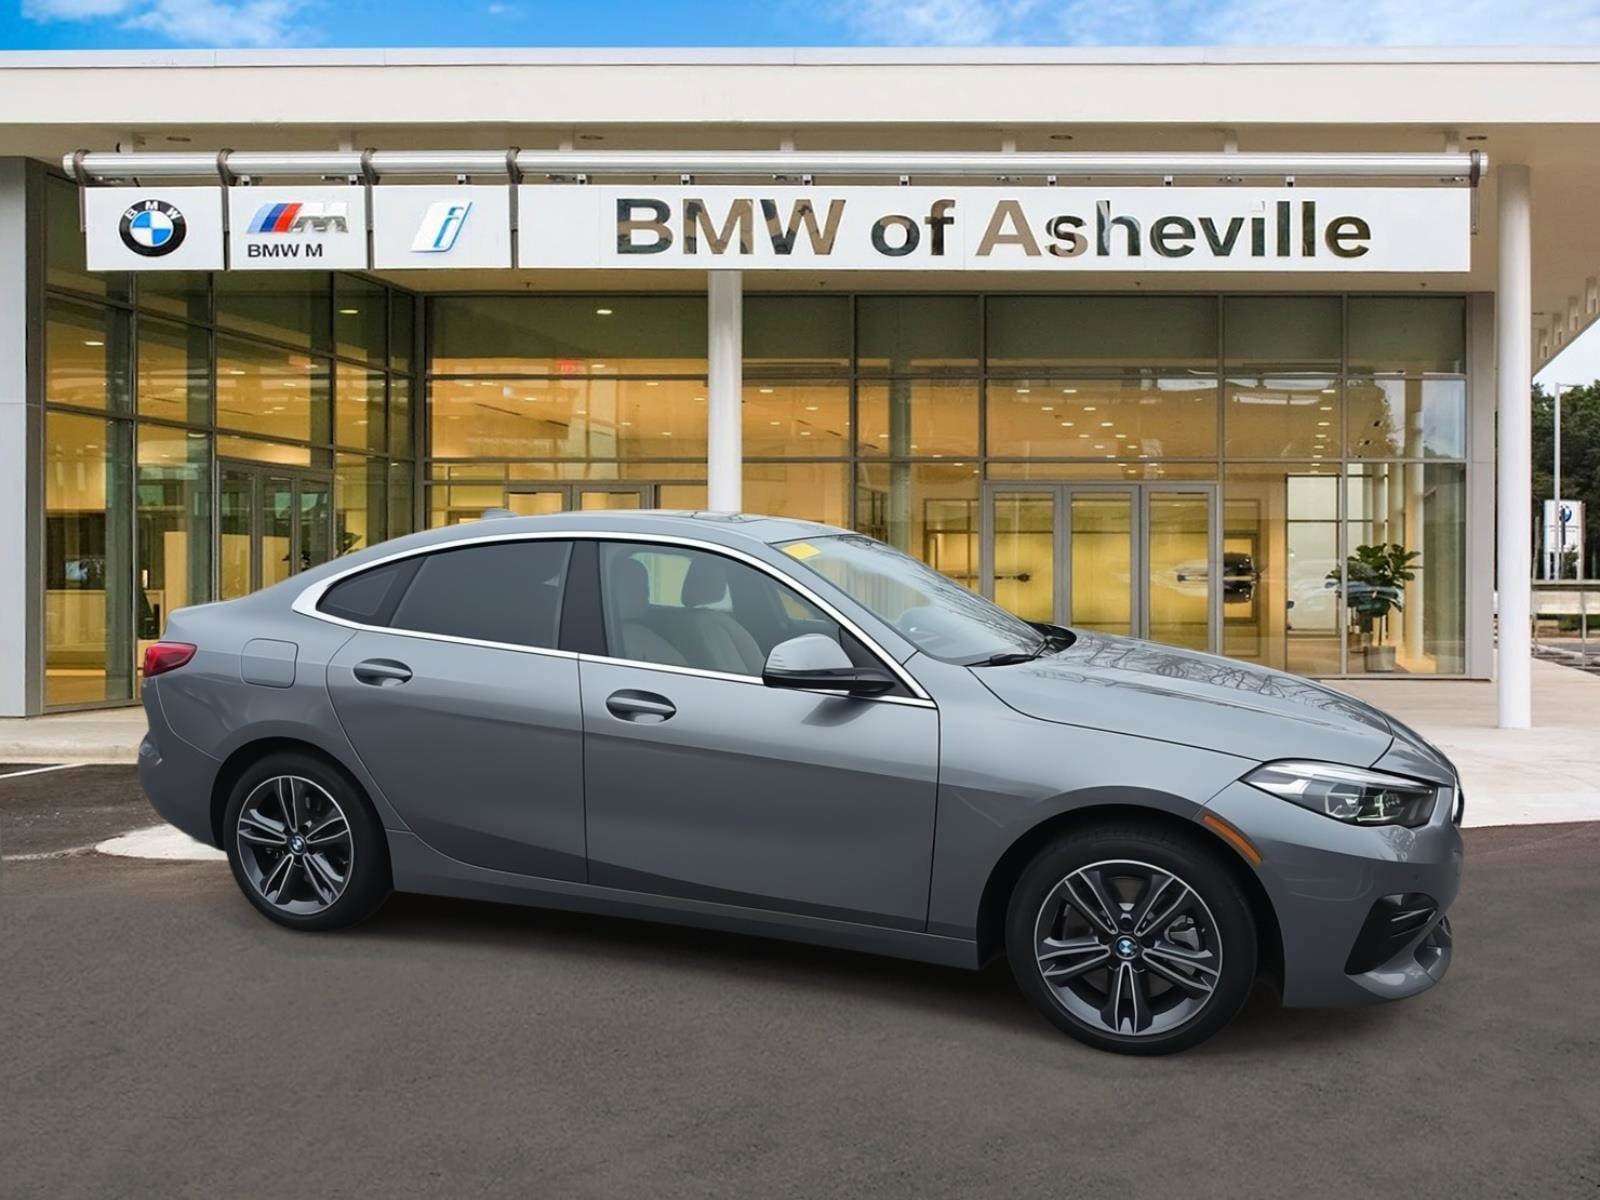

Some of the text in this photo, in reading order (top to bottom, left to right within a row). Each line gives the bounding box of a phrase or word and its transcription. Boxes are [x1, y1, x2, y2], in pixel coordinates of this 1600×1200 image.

[125, 201, 181, 220] BMW
[616, 198, 1372, 259] BMW of Asheville
[247, 243, 323, 258] BMW M
